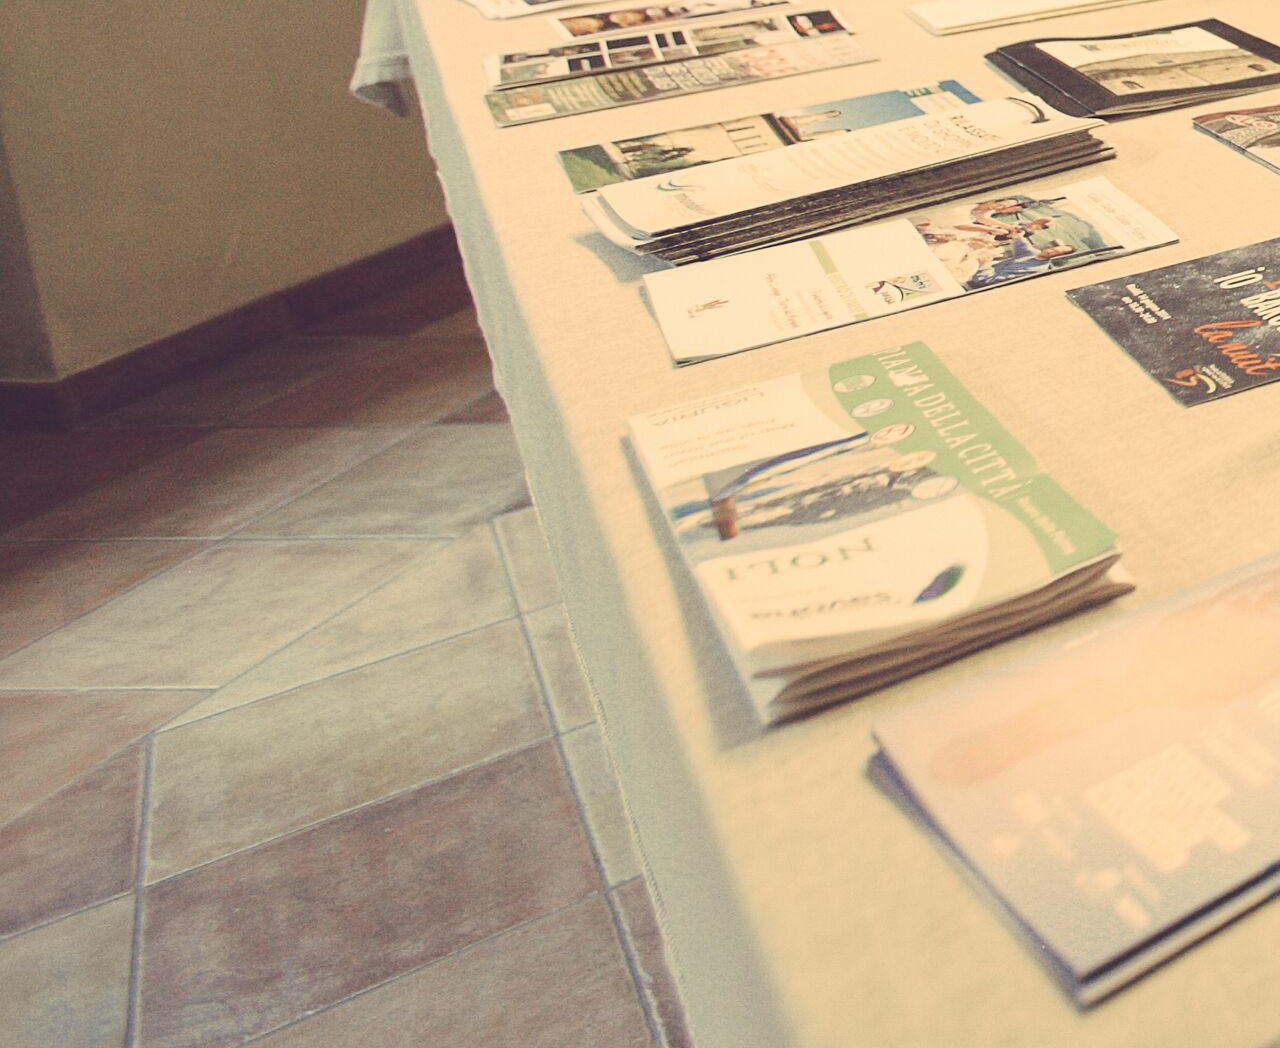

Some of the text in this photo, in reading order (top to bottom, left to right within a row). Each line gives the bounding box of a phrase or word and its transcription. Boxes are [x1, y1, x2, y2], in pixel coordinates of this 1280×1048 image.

[873, 345, 1035, 499] PIANA DELLA CITTÀ
[724, 537, 877, 582] NOLI
